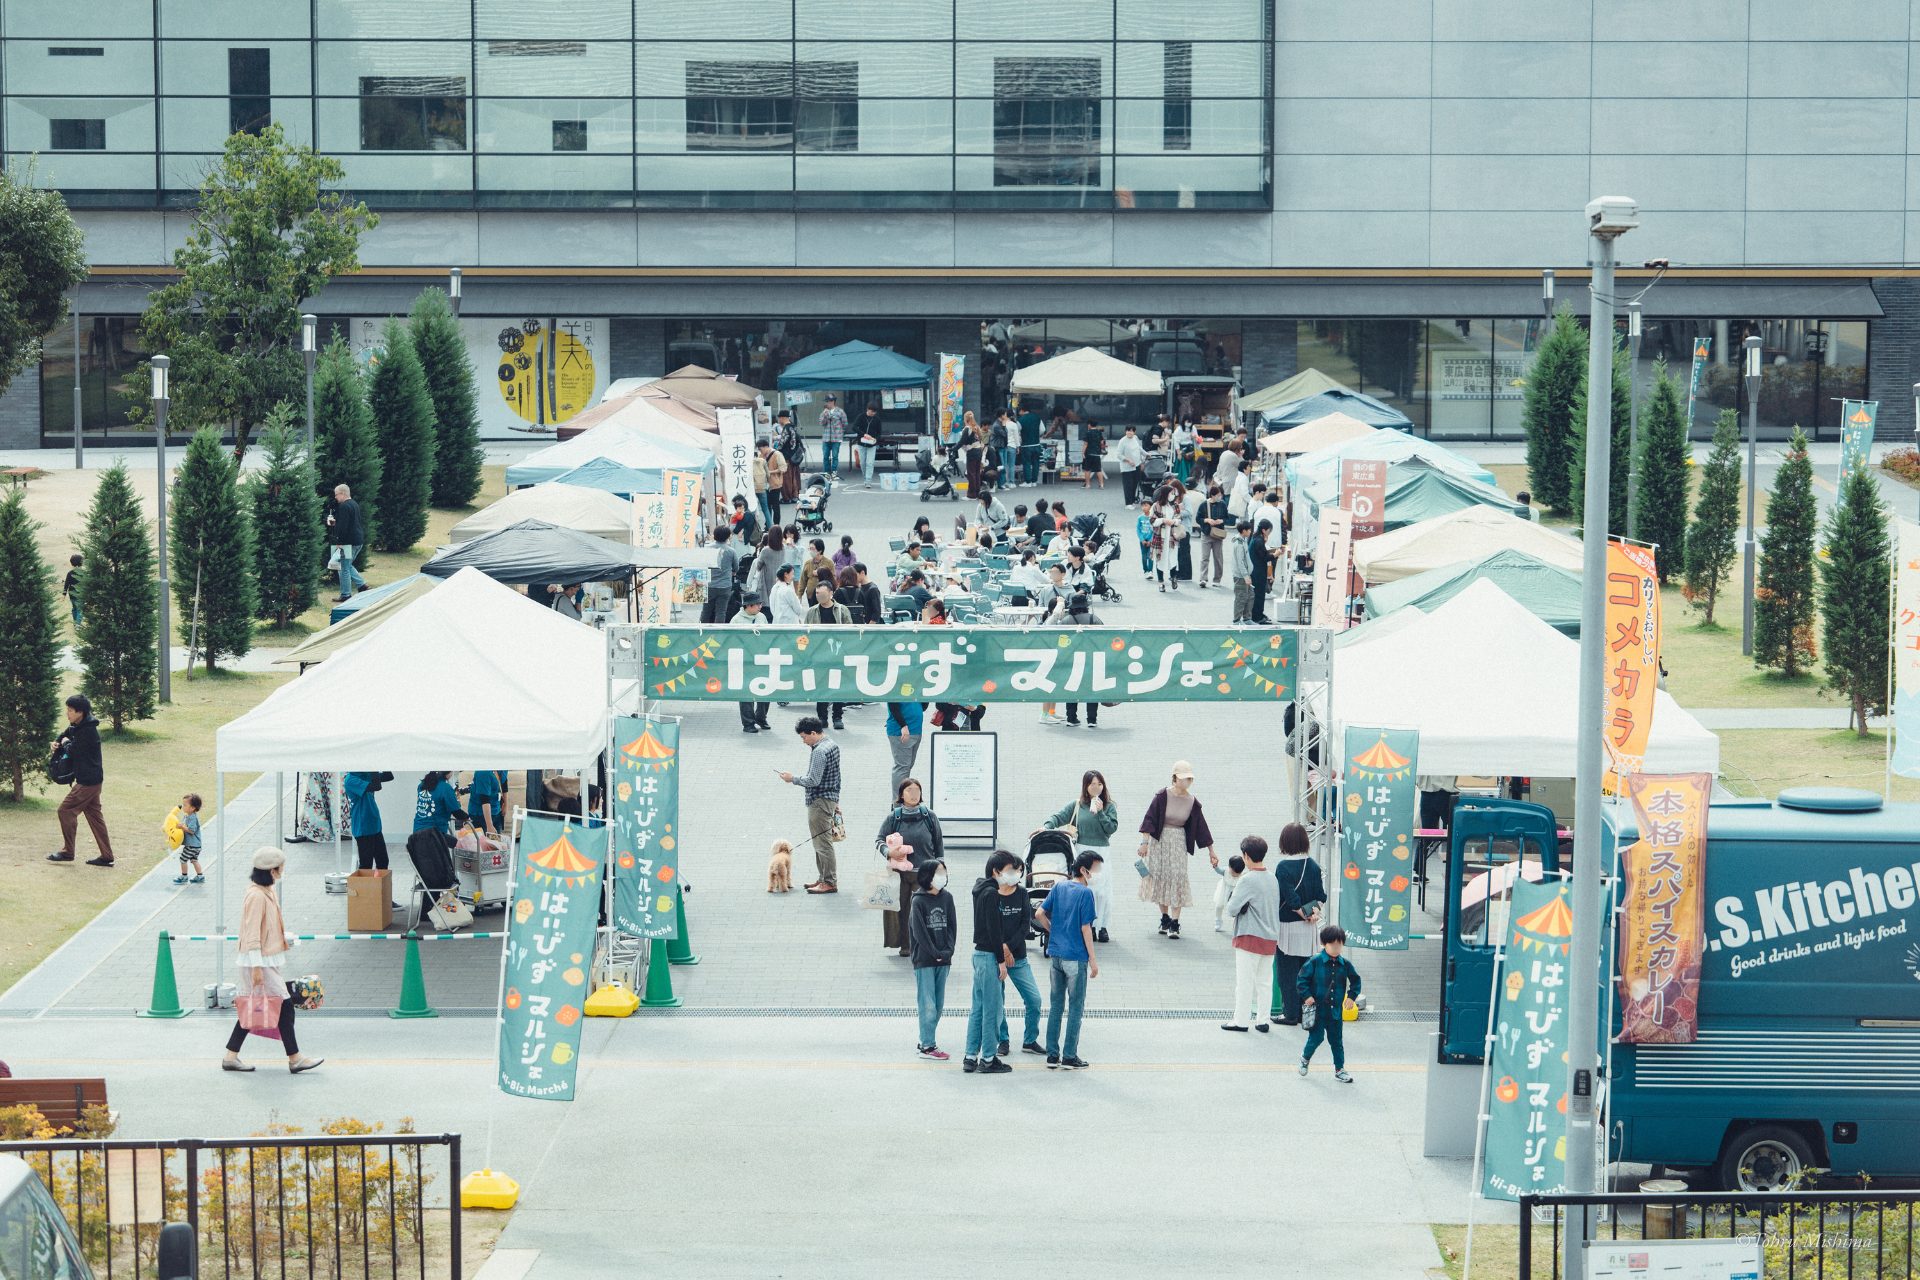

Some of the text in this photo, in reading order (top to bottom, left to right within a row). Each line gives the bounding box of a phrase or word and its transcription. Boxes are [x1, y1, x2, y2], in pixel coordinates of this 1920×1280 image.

[560, 320, 583, 370] 美
[583, 320, 594, 370] 日本刀の
[1003, 642, 1214, 695] マルシェ
[638, 857, 653, 924] マルシェ
[1364, 869, 1386, 935] マルシェ
[1645, 788, 1686, 1025] 本格スパイスカレー
[618, 915, 673, 937] Hi-Biz Marché
[1344, 928, 1404, 948] Hi-Biz Marché
[1730, 919, 1908, 978] Good drinks and light food
[520, 994, 552, 1080] マルシェ
[501, 1071, 569, 1095] Hi-Biz Marché
[1523, 1082, 1551, 1182] マルシェ
